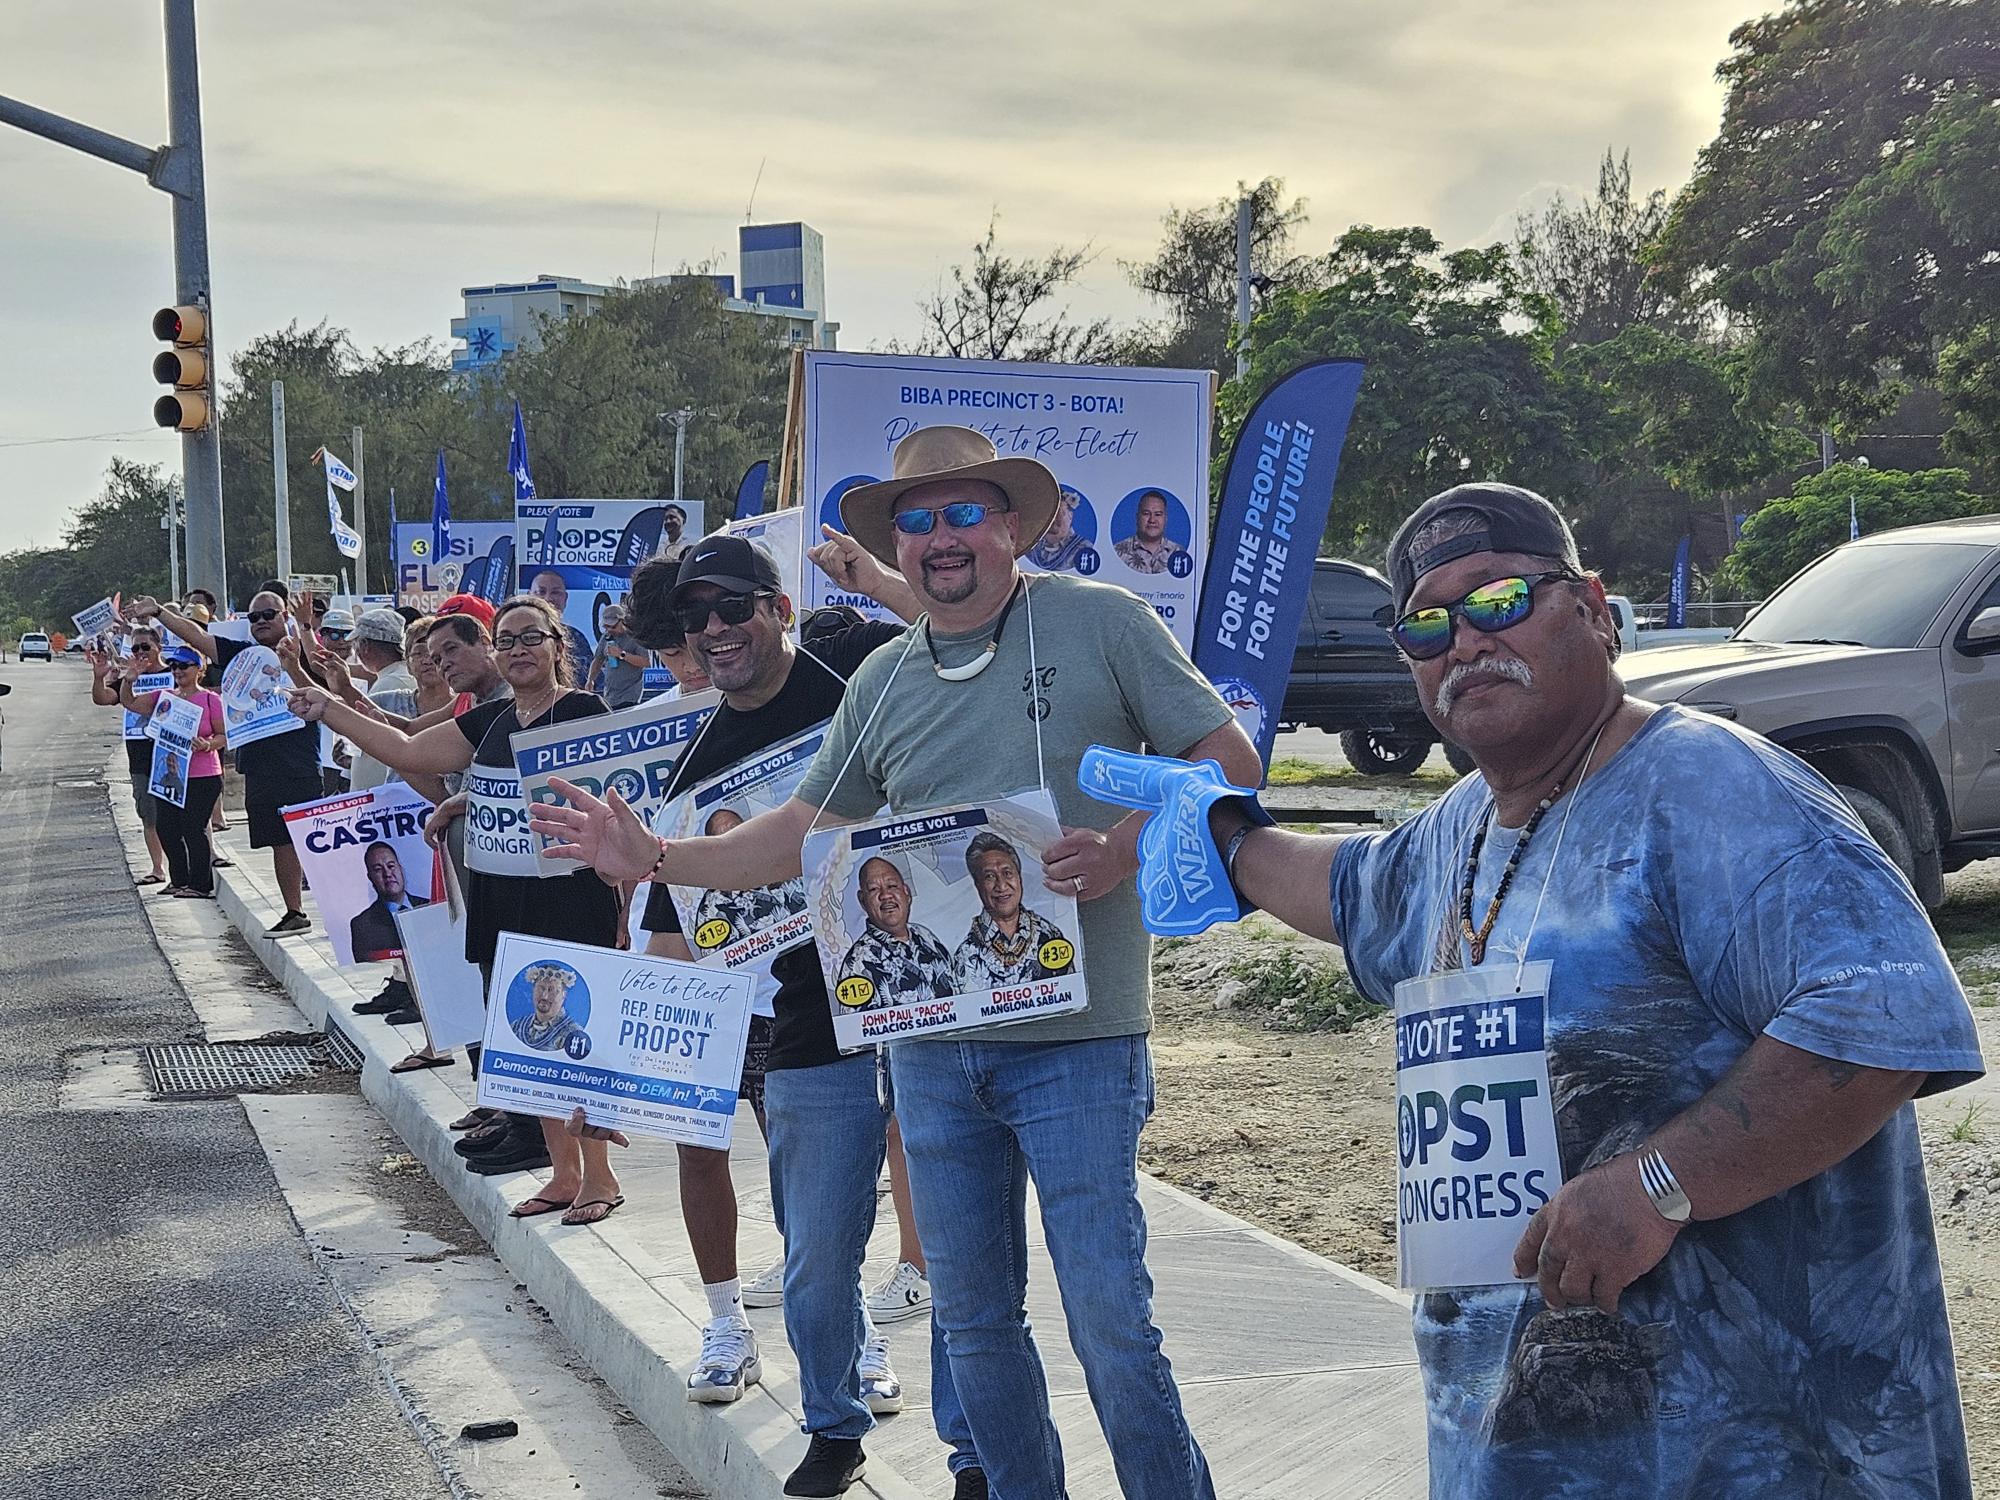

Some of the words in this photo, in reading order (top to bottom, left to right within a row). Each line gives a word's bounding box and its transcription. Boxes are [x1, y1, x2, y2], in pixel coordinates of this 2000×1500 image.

[900, 386, 943, 405] BIBA
[948, 389, 1039, 410] PRECINCT
[1043, 394, 1054, 411] 3
[1071, 395, 1124, 414] BOTA!
[1010, 425, 1031, 450] to
[1035, 427, 1138, 459] Re-Elect!
[1244, 420, 1291, 531] PEOPLE,
[1272, 419, 1315, 541] FUTURE!
[526, 507, 552, 516] PLEAS
[558, 508, 581, 517] VOTE
[450, 537, 474, 556] Si
[527, 529, 625, 549] POPS
[558, 551, 614, 563] CONGRE
[1080, 553, 1095, 571] #1
[1173, 556, 1188, 574] #1
[1231, 528, 1261, 586] THE
[1258, 539, 1289, 597] THE
[825, 595, 883, 609] CAMAC
[1217, 590, 1248, 651] FOR
[1245, 600, 1276, 660] FOR
[537, 734, 622, 770] PLEASE
[626, 718, 688, 750] VOTE
[721, 765, 762, 793] PLEASE
[763, 750, 795, 772] VOTE
[313, 801, 344, 815] PLEASE
[346, 797, 368, 808] VOTE
[468, 800, 530, 835] ROPS
[880, 822, 924, 840] PLEASE
[926, 816, 957, 830] VOTE
[478, 835, 534, 855] CONGR
[699, 927, 715, 944] #1
[723, 943, 749, 961] JOHN
[749, 932, 774, 947] PAUL
[773, 912, 812, 935] "PACHO"
[726, 941, 776, 969] PALACIOS
[1042, 946, 1059, 962] #3
[1881, 960, 1926, 976] Oregon
[619, 968, 659, 992] Vote
[661, 974, 682, 995] to
[682, 977, 738, 1004] Elect
[841, 985, 857, 999] #1
[992, 988, 1032, 1004] DIEGO
[1034, 981, 1059, 996] "DJ"
[621, 998, 649, 1019] REP.
[654, 1003, 701, 1028] EDWIN
[704, 1011, 718, 1030] K.
[861, 1012, 888, 1028] JOHN
[888, 1008, 913, 1022] PAUL
[914, 1000, 954, 1016] "PACHO"
[980, 1001, 1036, 1017] MANGLONA
[1036, 992, 1072, 1007] SABLAN
[618, 1019, 711, 1060] PROPST
[862, 1020, 915, 1038] PALACIOS
[916, 1013, 957, 1028] SABLAN
[1407, 1015, 1465, 1059] VOTE
[1475, 1006, 1518, 1049] #1
[570, 1036, 587, 1056] #1
[493, 1057, 559, 1079] Democrats
[561, 1069, 608, 1087] Deliver!
[610, 1077, 638, 1093] Vote
[640, 1082, 672, 1098] DEM
[1398, 1079, 1539, 1169] OPST
